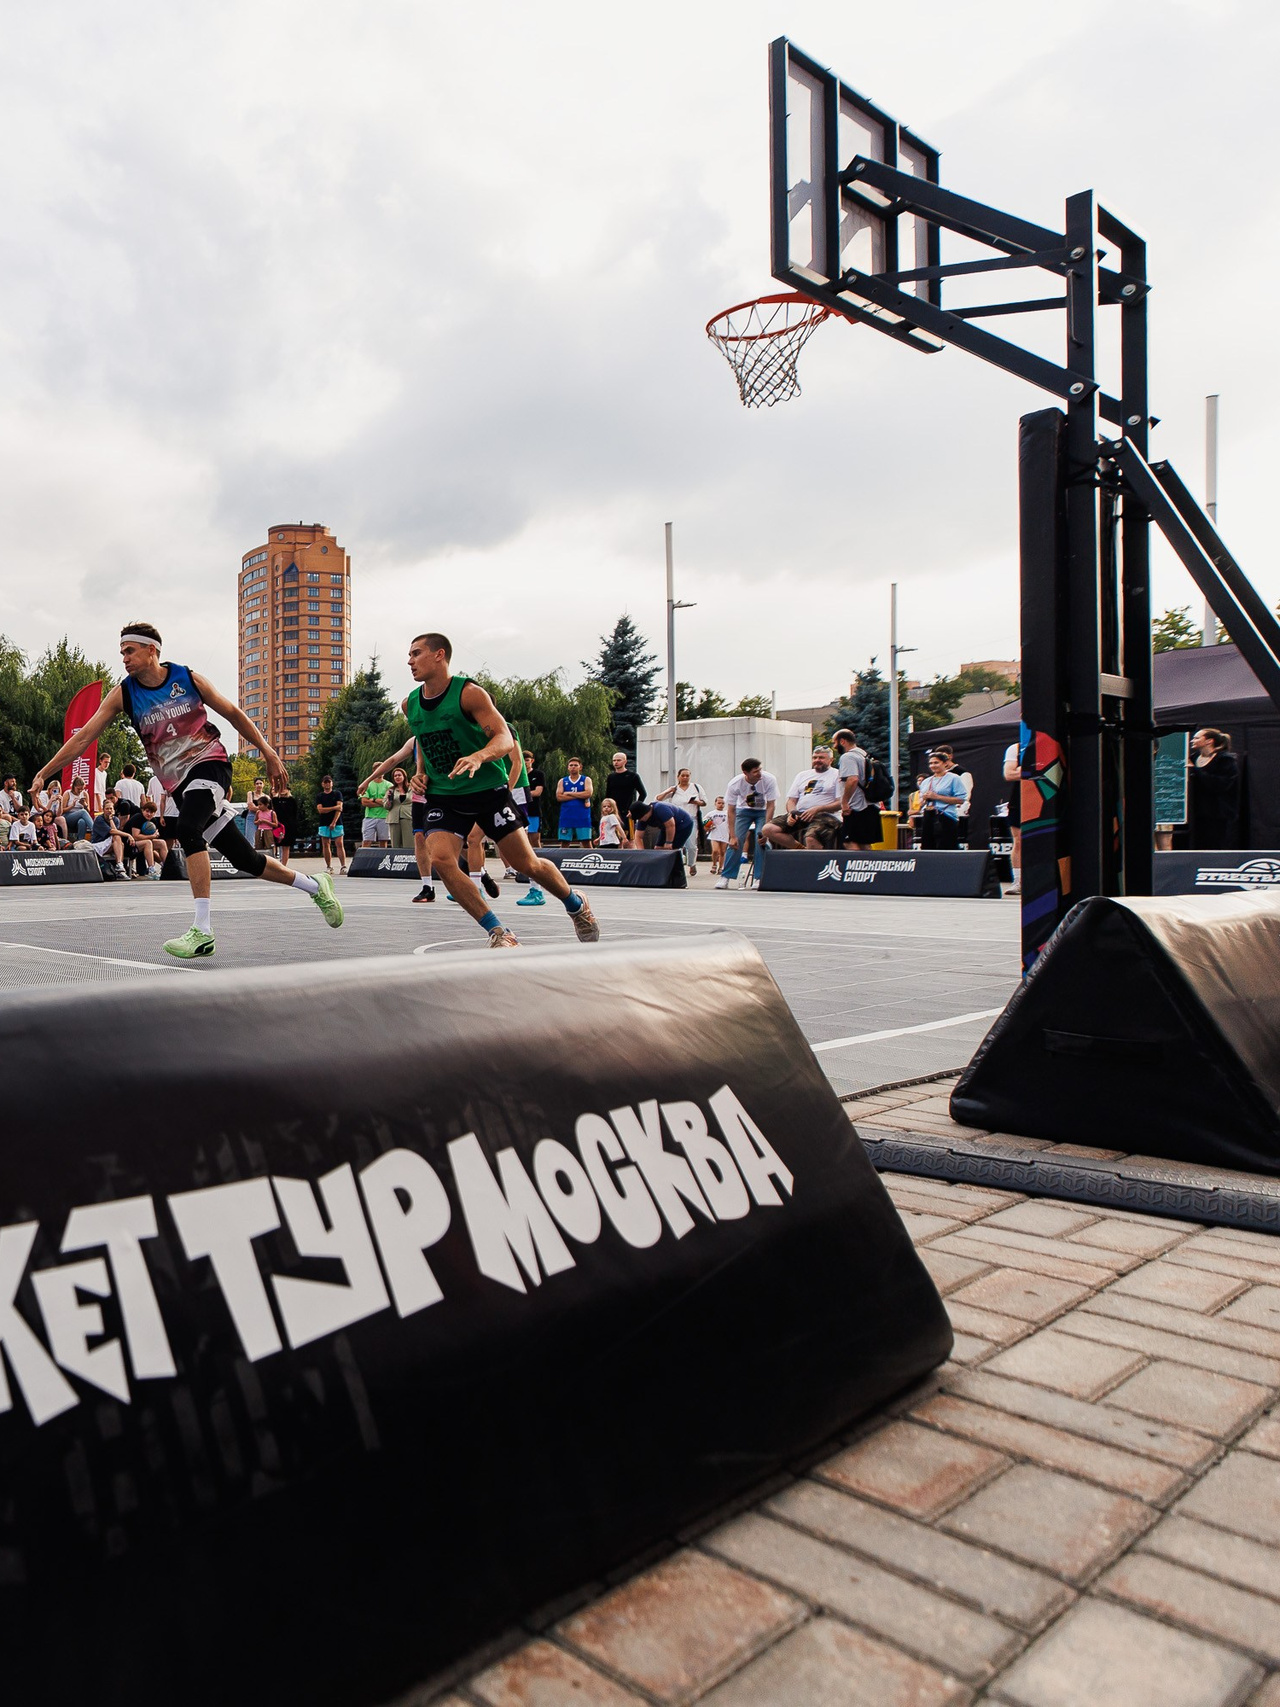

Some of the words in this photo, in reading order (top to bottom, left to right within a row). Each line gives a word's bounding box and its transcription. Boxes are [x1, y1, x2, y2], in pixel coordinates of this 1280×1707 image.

[144, 709, 165, 726] ALPHA
[165, 703, 192, 719] YOUNG
[167, 723, 178, 736] 4
[494, 806, 516, 827] 43
[25, 856, 65, 867] МОСКОВСКИЙ
[560, 861, 621, 870] STREETBASKET
[846, 858, 917, 872] МОСКОВСКИЙ
[27, 867, 47, 876] СПОРТ
[843, 871, 877, 883] СПОРТ
[167, 1149, 451, 1362] ТУР
[447, 1084, 794, 1294] МОСКВА
